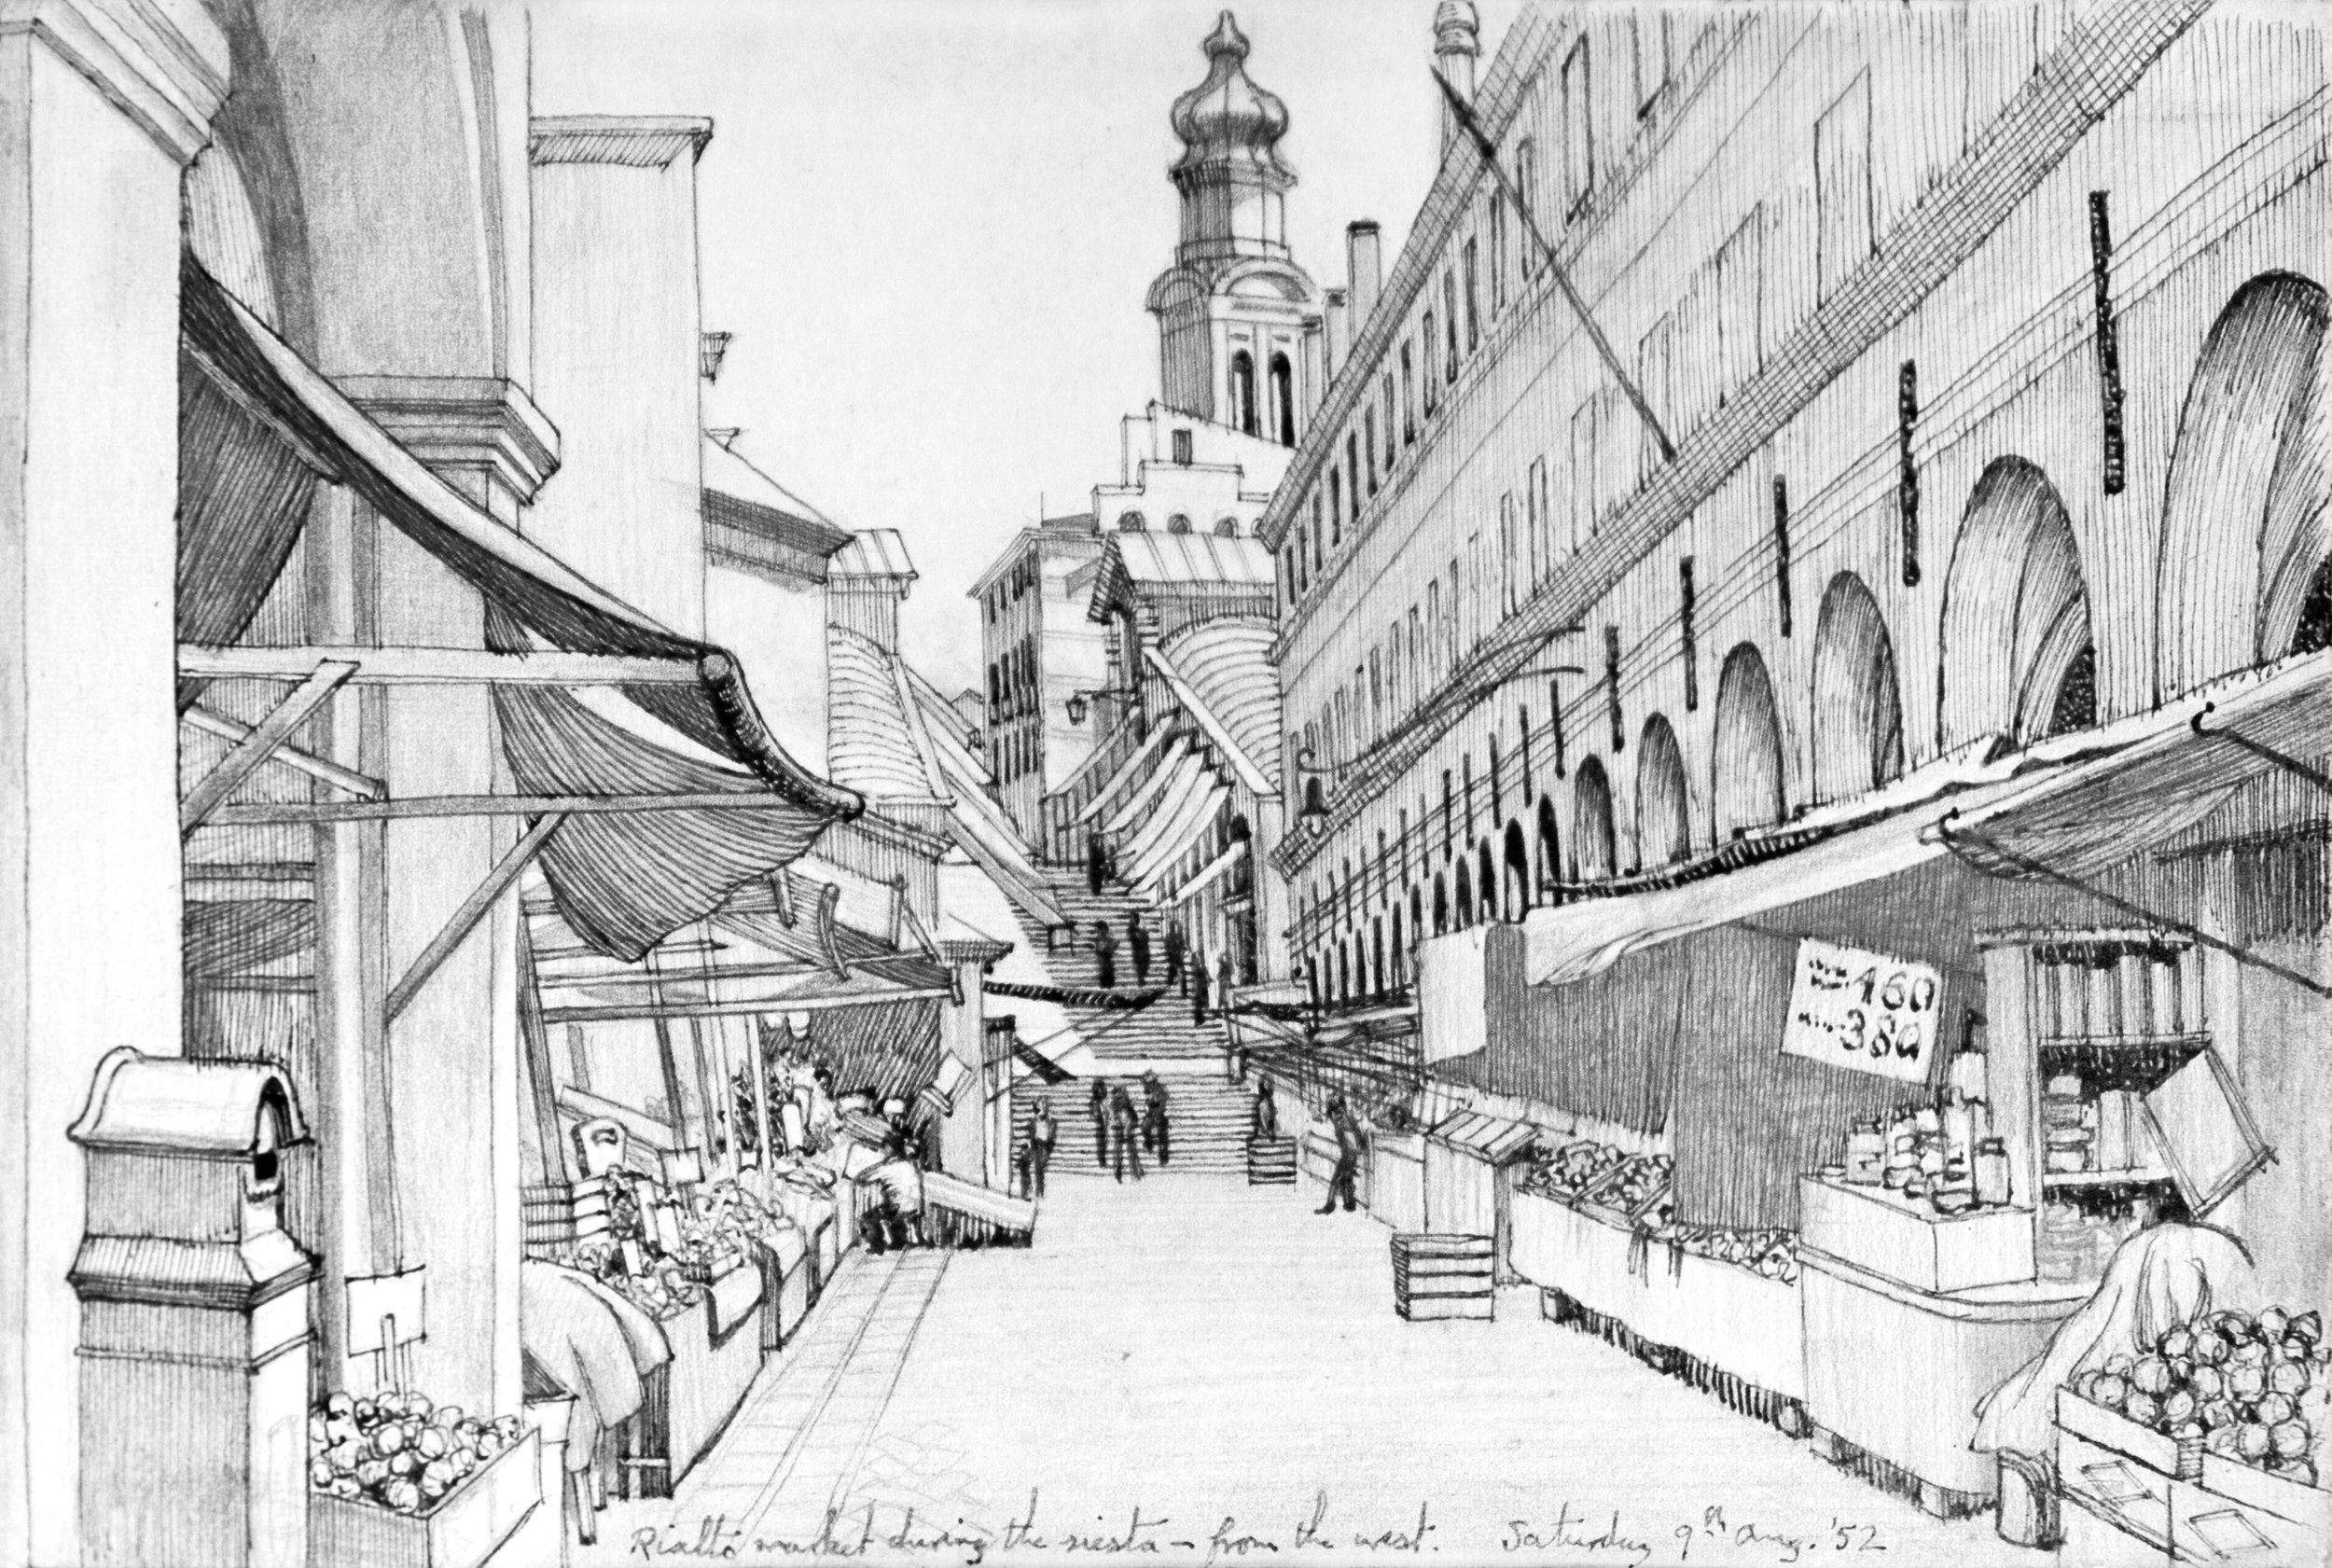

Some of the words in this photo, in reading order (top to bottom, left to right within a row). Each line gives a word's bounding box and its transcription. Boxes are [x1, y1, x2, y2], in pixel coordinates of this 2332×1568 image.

[631, 1514, 742, 1559] Rialto
[755, 1498, 874, 1556] market
[888, 1506, 986, 1566] during
[1002, 1487, 1047, 1552] the
[1059, 1505, 1169, 1553] siesta
[1210, 1515, 1277, 1559] from
[1294, 1490, 1334, 1550] the
[1354, 1501, 1438, 1555] west.
[1503, 1503, 1652, 1567] Saturday
